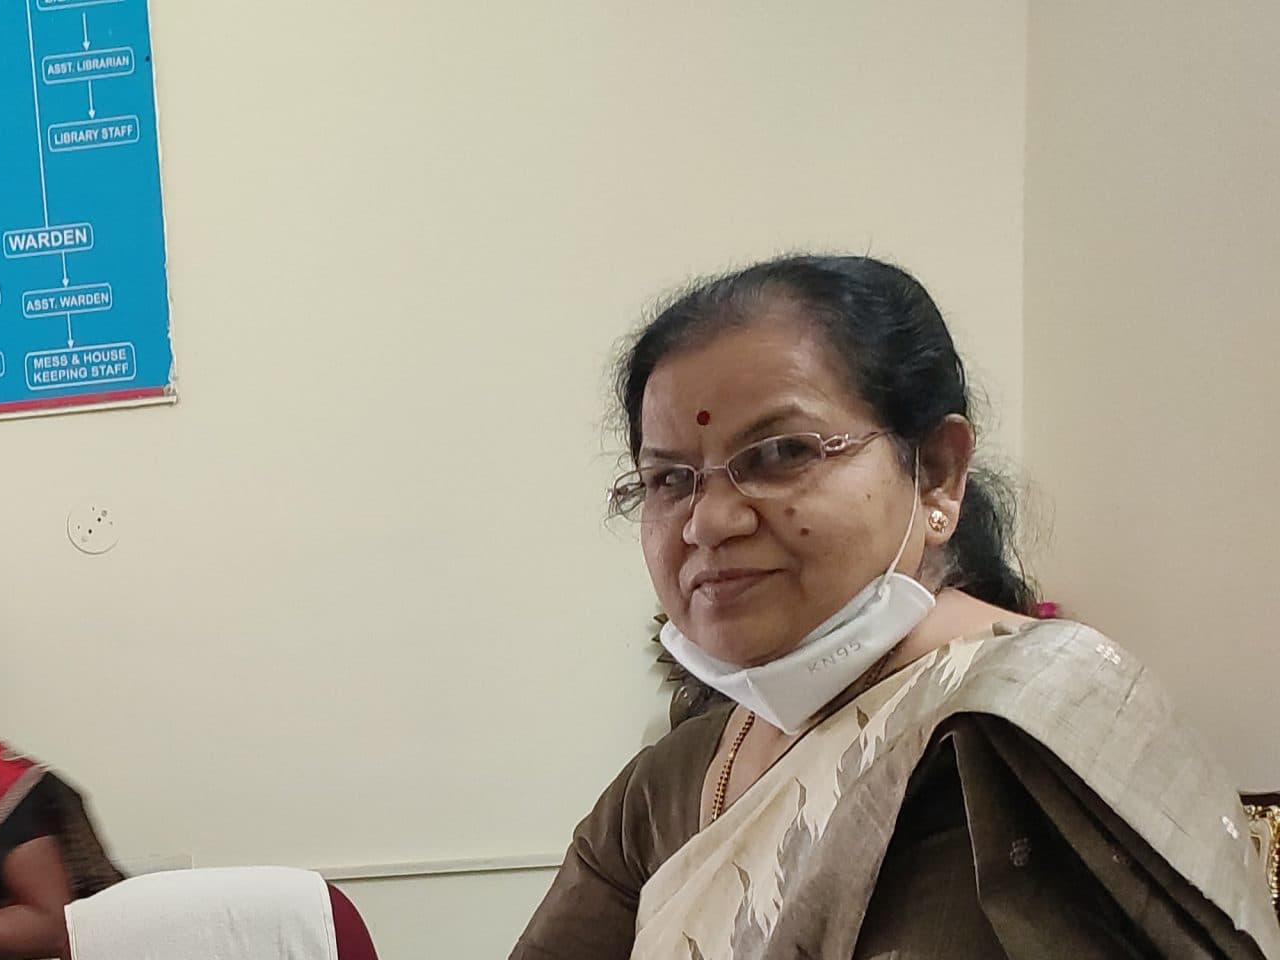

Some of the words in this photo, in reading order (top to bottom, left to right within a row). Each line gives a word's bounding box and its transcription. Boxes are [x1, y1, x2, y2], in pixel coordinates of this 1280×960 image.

[47, 62, 75, 75] ASST.
[76, 56, 130, 72] LIBRARIAN
[54, 129, 99, 145] LIBRARY
[101, 125, 133, 141] STAFF
[8, 230, 88, 251] WARDEN
[26, 298, 56, 312] ASST.
[59, 292, 110, 309] WARDEN
[33, 355, 68, 369] MESS
[71, 354, 80, 366] &
[83, 348, 127, 365] HOUSE
[33, 368, 88, 383] KEEPING
[91, 363, 129, 380] STAFF
[806, 639, 862, 675] KN95
